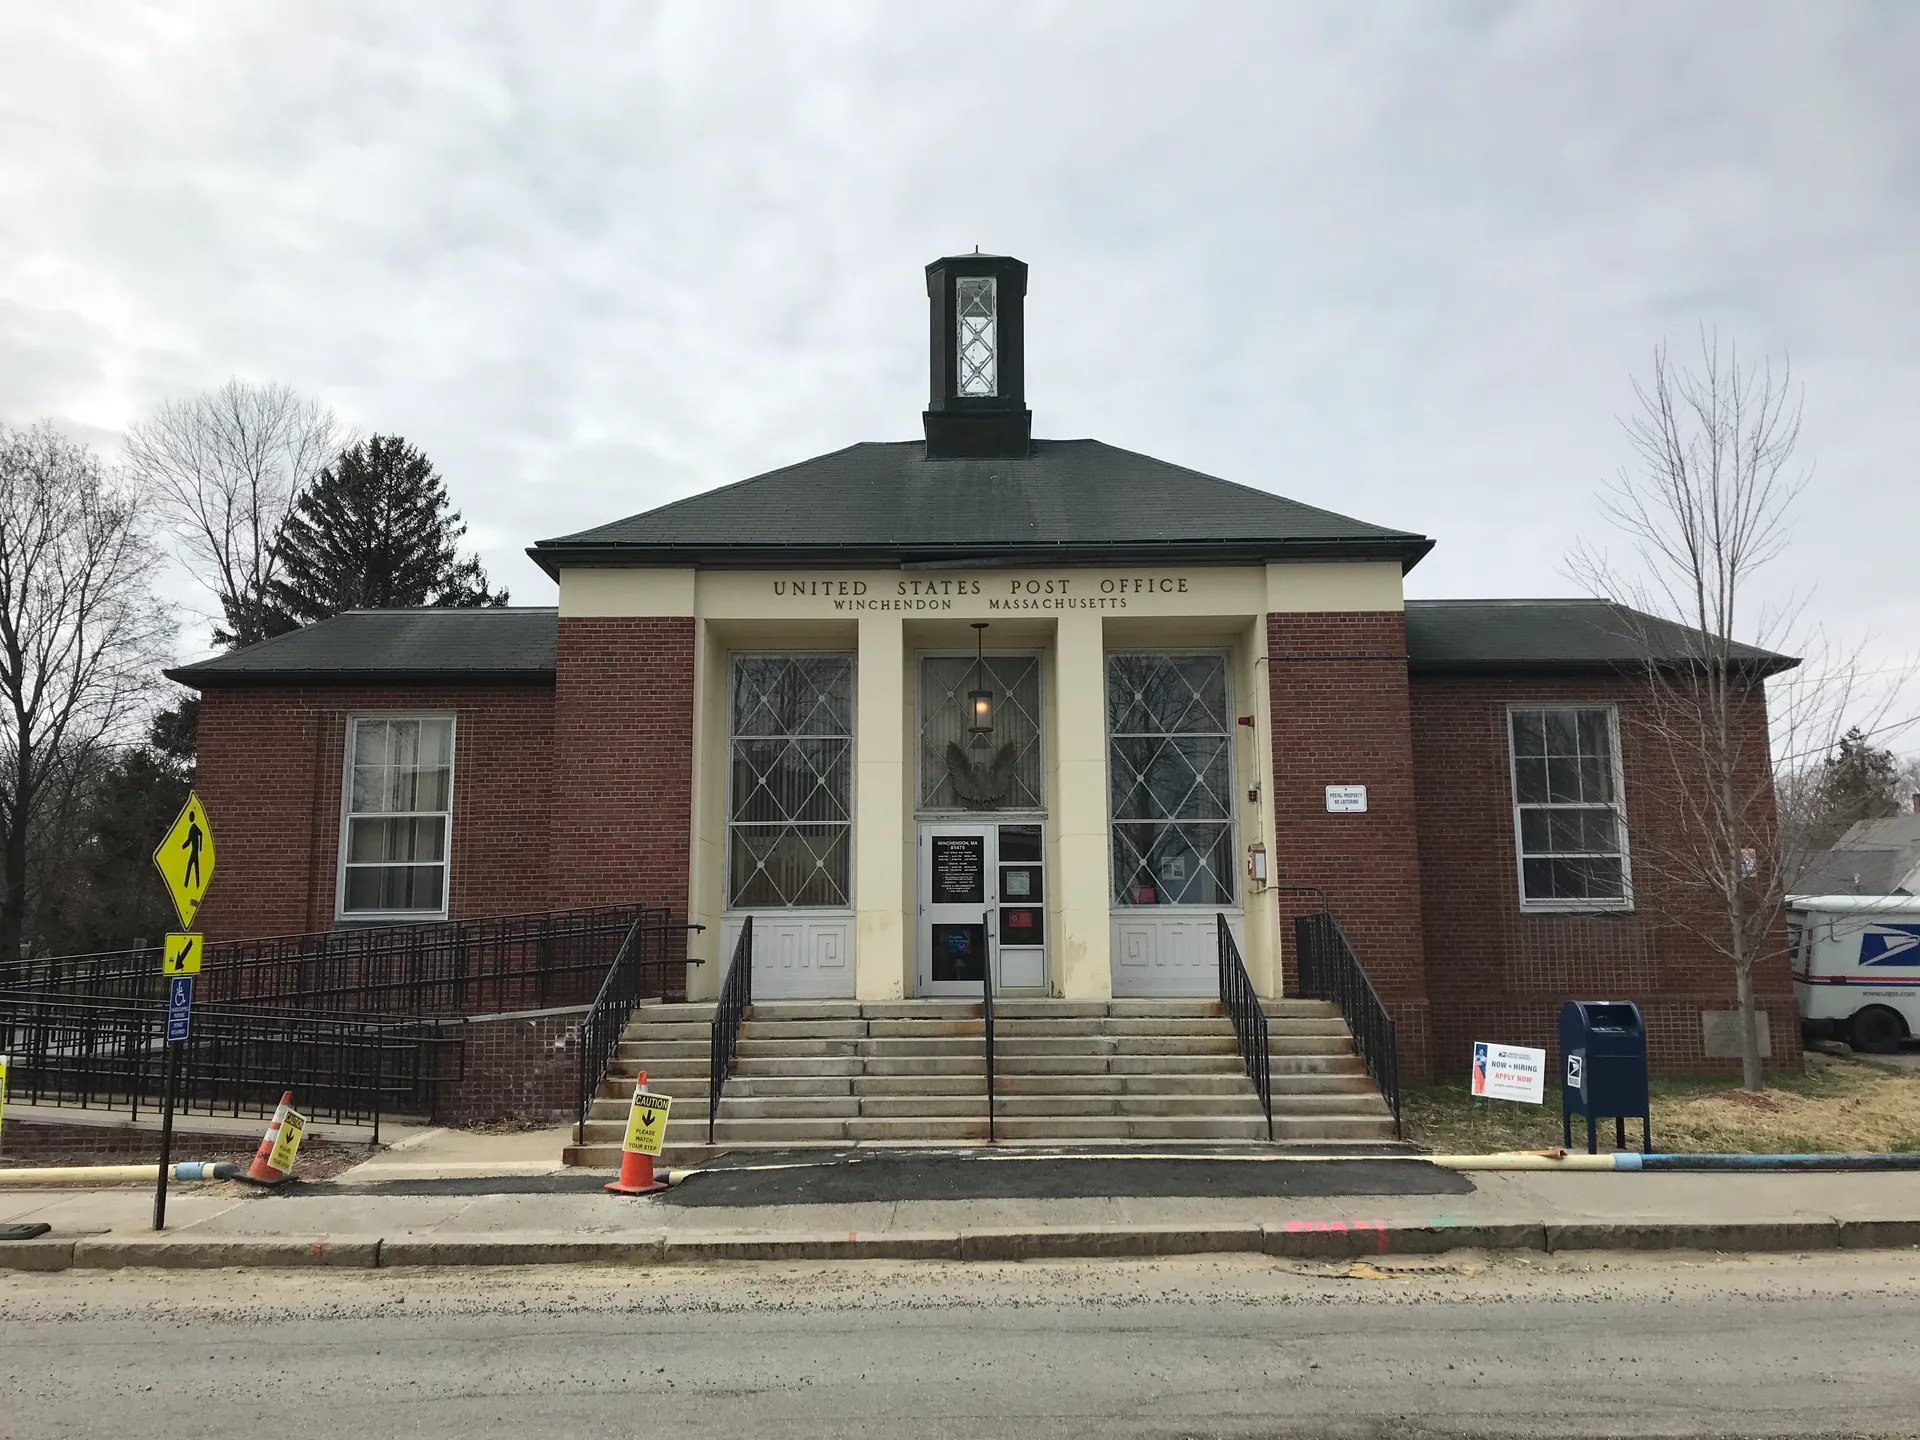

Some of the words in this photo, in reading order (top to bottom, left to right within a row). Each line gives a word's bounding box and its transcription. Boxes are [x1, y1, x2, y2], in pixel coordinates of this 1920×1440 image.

[773, 581, 867, 596] UNITED
[897, 580, 981, 595] STATES
[1010, 580, 1070, 594] POST
[1100, 578, 1189, 593] OFFICE
[834, 599, 951, 610] WINCHENDON
[989, 598, 1127, 609] MASSACHUSETTS
[1491, 1060, 1508, 1069] NOW
[1513, 1063, 1538, 1073] HIRING
[1495, 1072, 1515, 1081] APPLY
[1516, 1075, 1533, 1083] NOW
[635, 1095, 669, 1110] CAUTION
